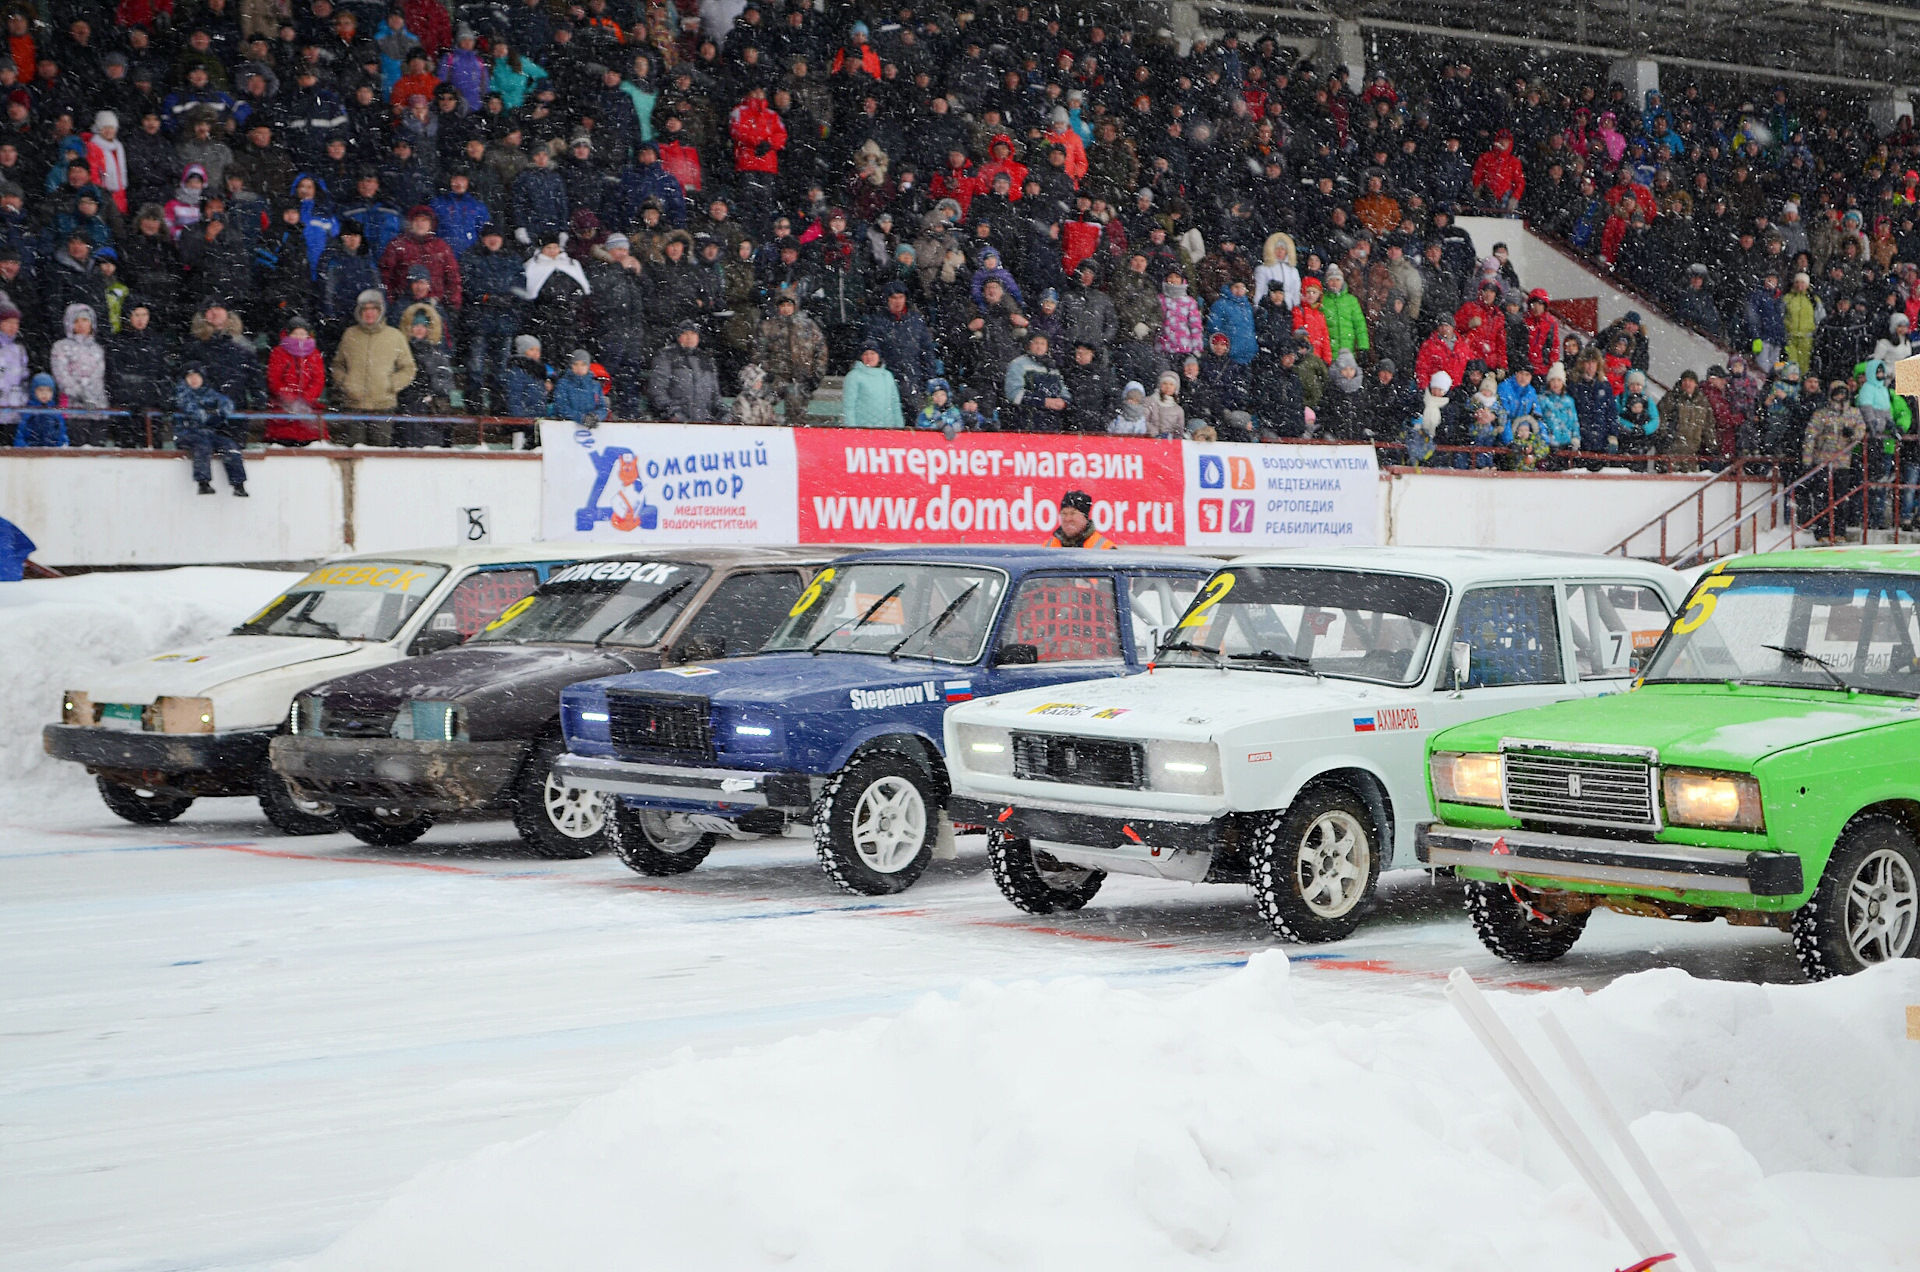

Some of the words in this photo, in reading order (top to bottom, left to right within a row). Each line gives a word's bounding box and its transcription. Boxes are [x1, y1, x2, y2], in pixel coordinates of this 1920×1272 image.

[844, 446, 1144, 484] интернет-магазин
[1262, 457, 1369, 470] ВОДООЧИСТИТЕЛИ
[1267, 478, 1341, 492] МЕДТЕХНИКА
[813, 484, 1174, 533] www.domdoor.ru
[1267, 500, 1334, 514] ОРТОПЕДИЯ
[1265, 522, 1353, 536] РЕАБИЛИТАЦИЯ
[789, 568, 836, 617] 6
[1178, 573, 1236, 628] 2
[1672, 575, 1736, 634] 5
[486, 596, 535, 631] 9
[1610, 635, 1623, 665] 7
[849, 683, 923, 710] Stepanov
[922, 681, 940, 702] V.
[1377, 708, 1419, 731] АХМАРОВ
